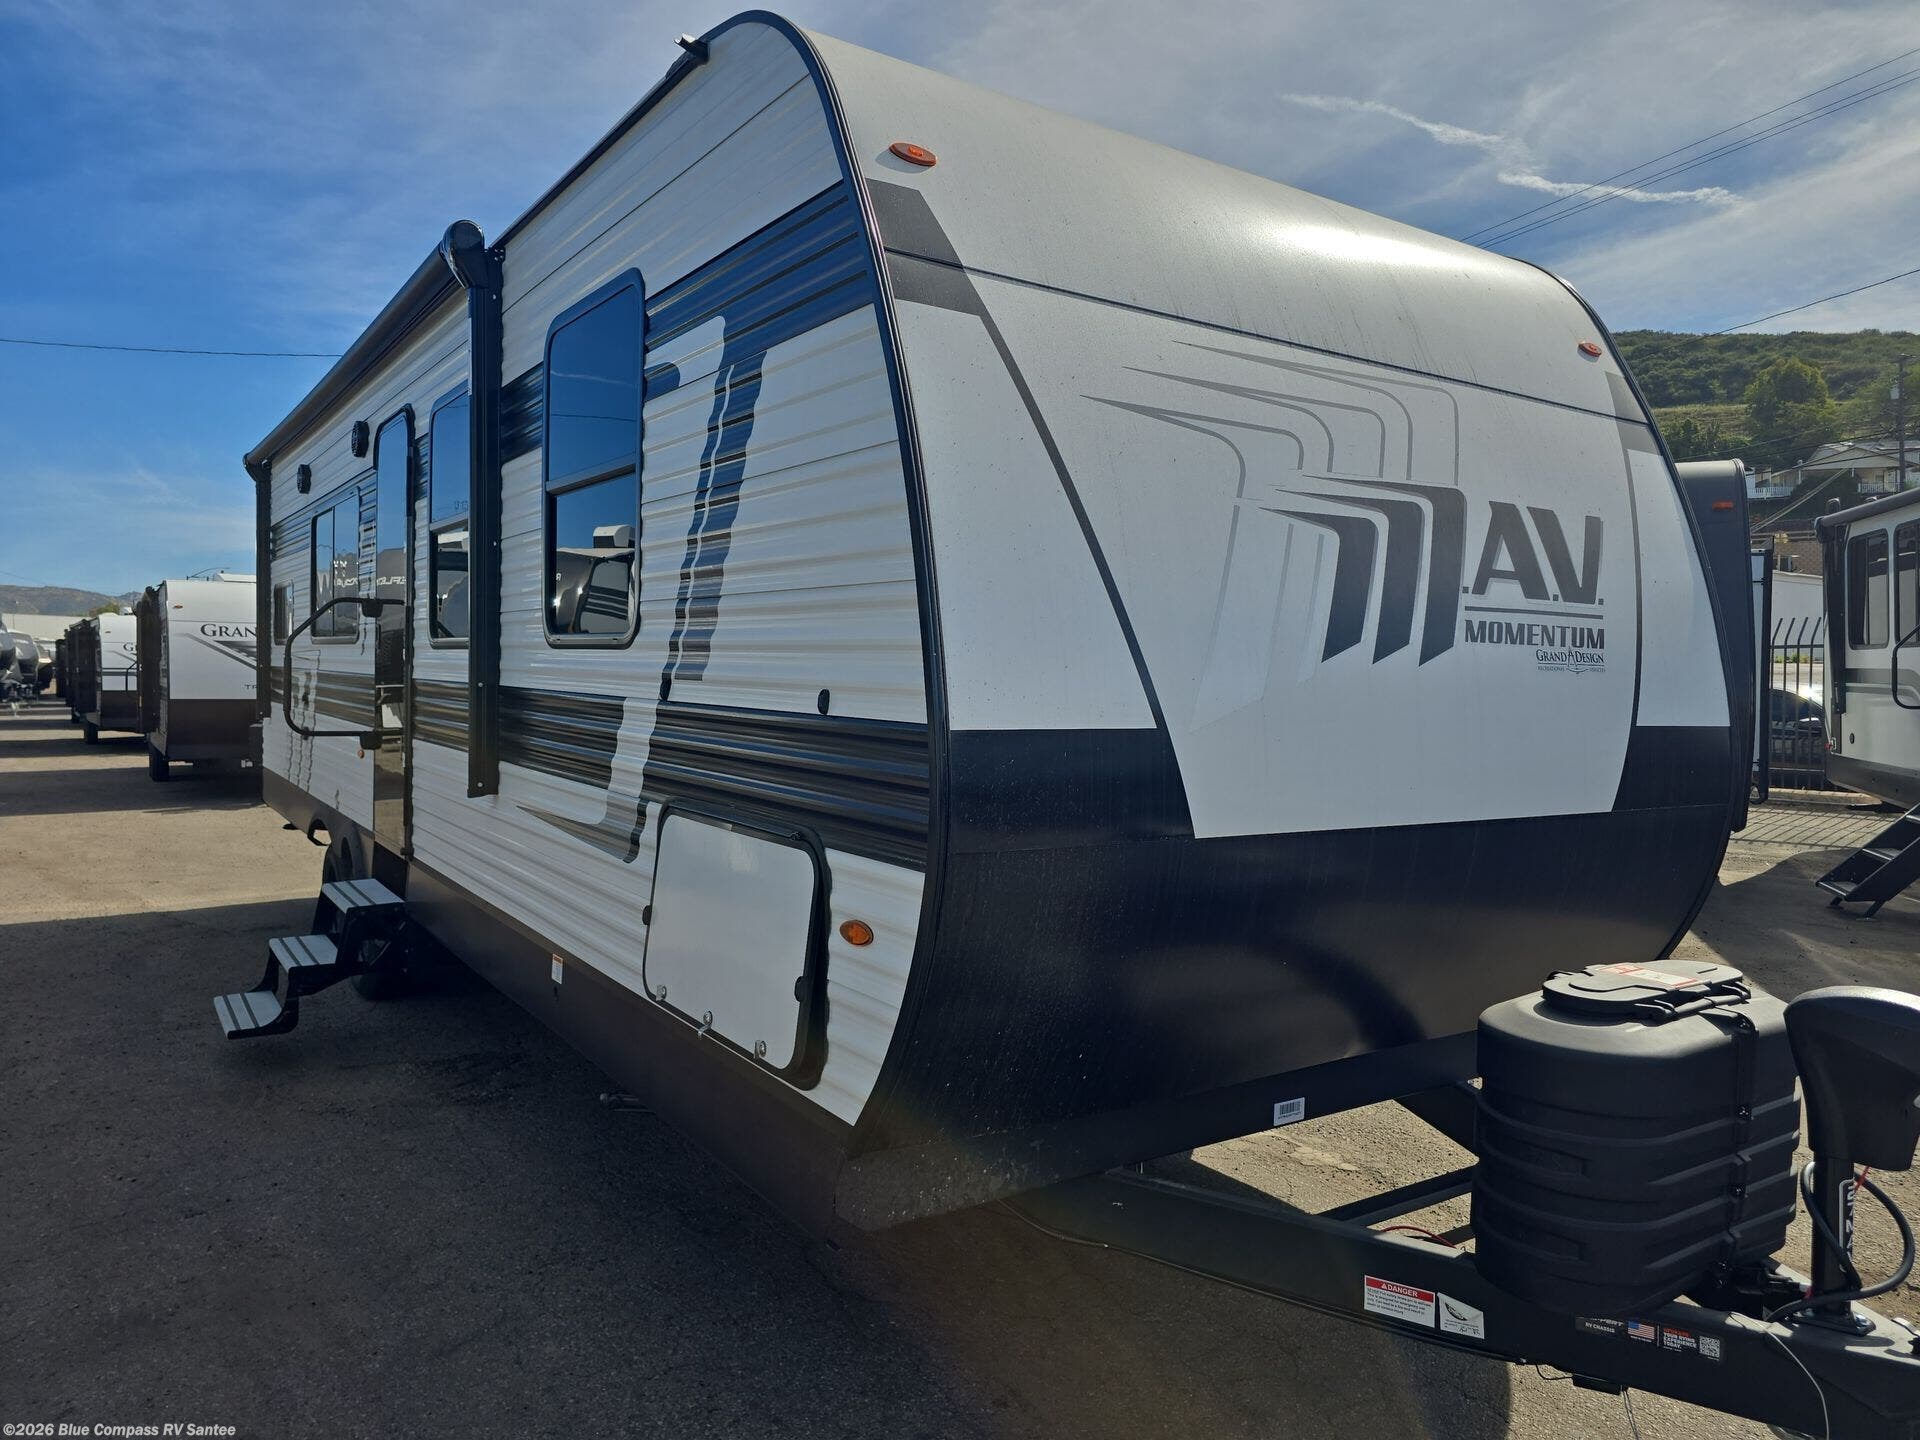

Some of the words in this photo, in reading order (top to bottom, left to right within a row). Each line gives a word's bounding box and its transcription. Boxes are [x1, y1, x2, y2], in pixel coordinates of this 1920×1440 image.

[1464, 619, 1605, 650] MOMENTUM
[1536, 648, 1567, 662] GRAND
[1575, 650, 1604, 664] DESIGN
[1387, 1283, 1418, 1298] DANGER
